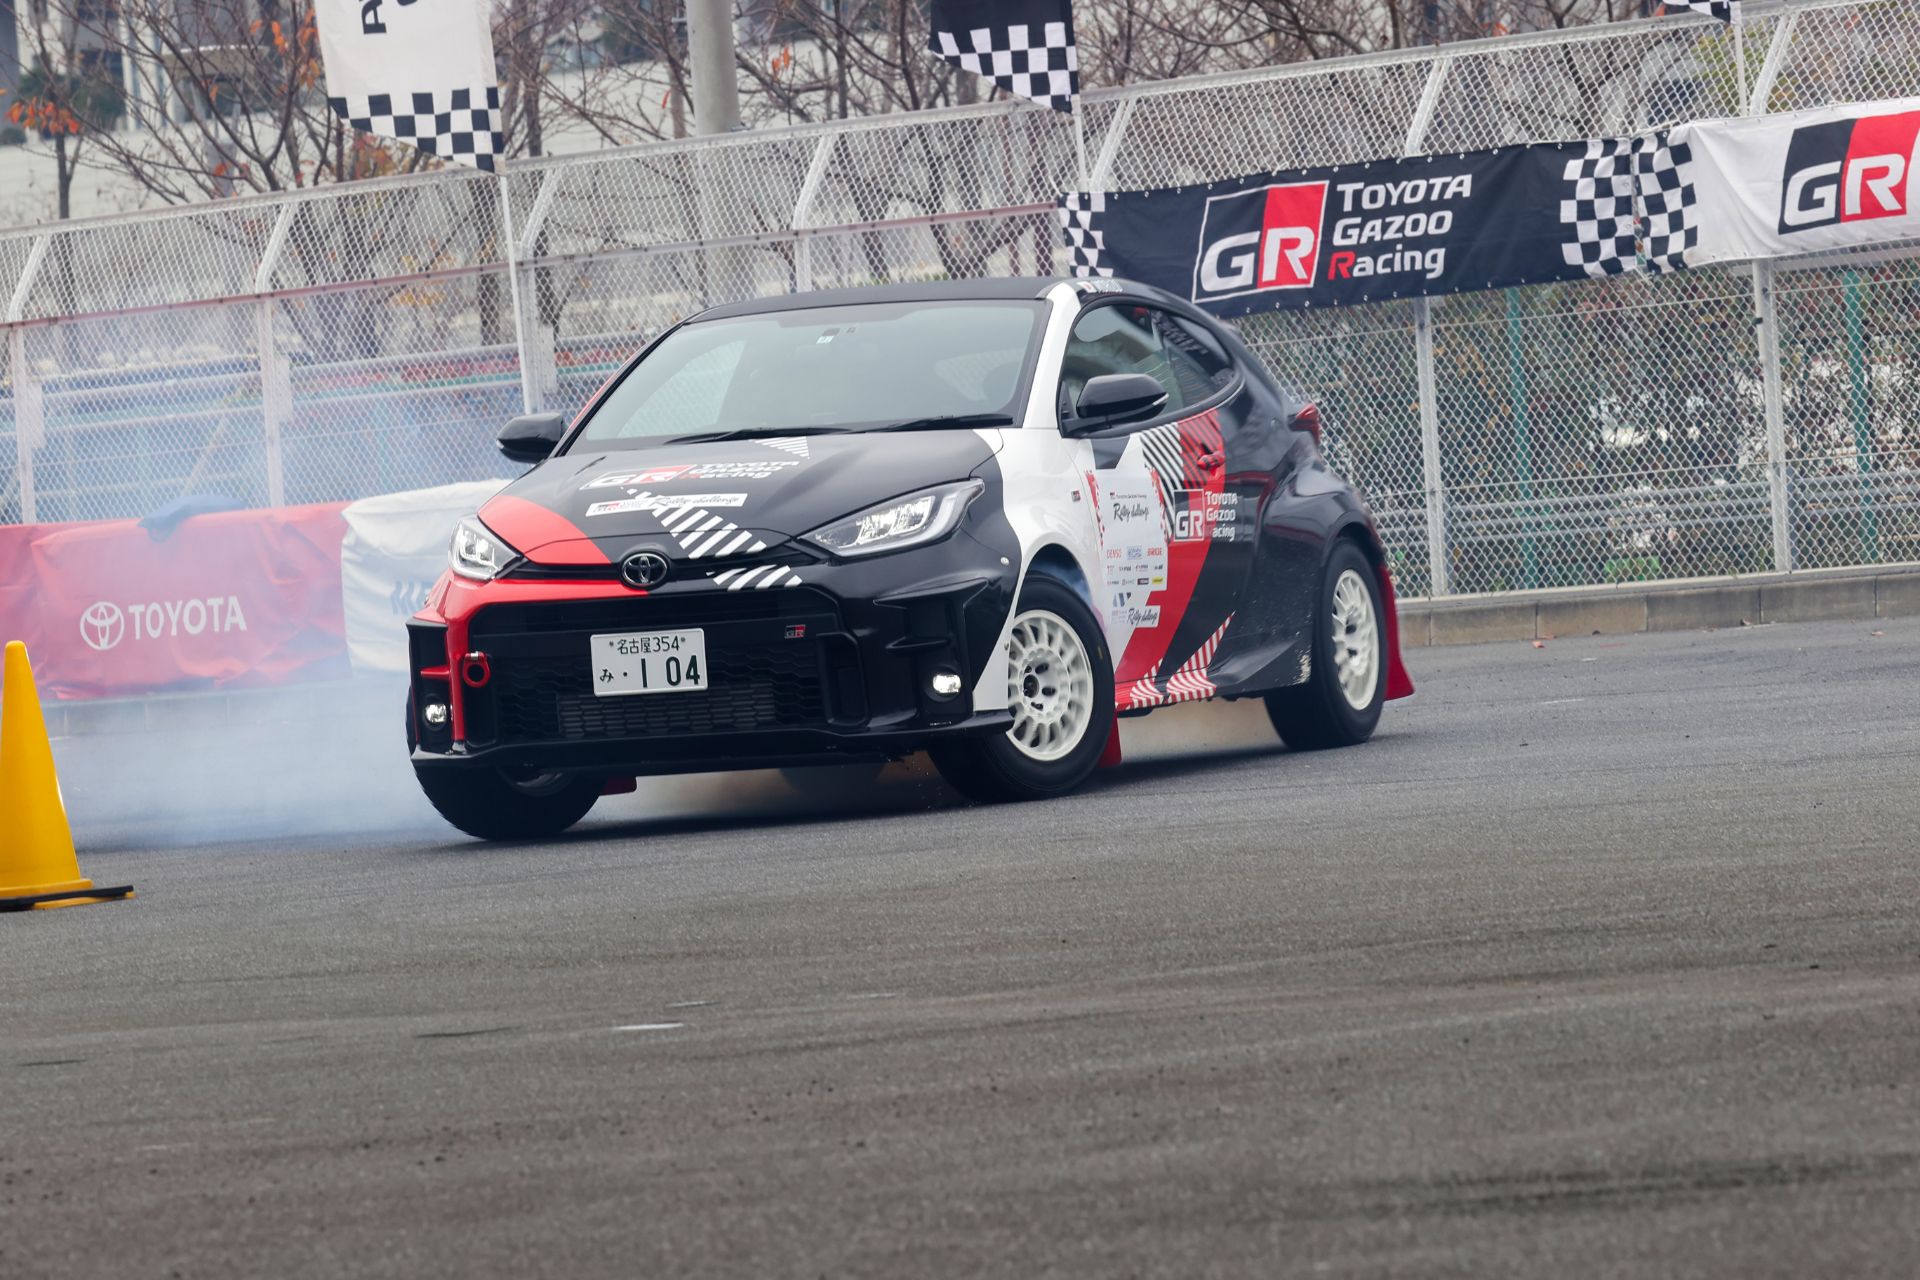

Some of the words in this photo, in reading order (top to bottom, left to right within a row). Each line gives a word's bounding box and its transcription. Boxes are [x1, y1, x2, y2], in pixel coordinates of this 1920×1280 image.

[1336, 173, 1472, 212] TOYOTA
[1784, 153, 1906, 227] GR
[1332, 209, 1453, 247] GAZOO
[1201, 227, 1315, 292] GR
[1327, 243, 1447, 280] Racing
[588, 471, 678, 487] GR
[1205, 490, 1238, 505] TOYOTA
[1175, 510, 1203, 538] GR
[1206, 507, 1236, 522] GAZOO
[128, 595, 247, 640] TOYOTA
